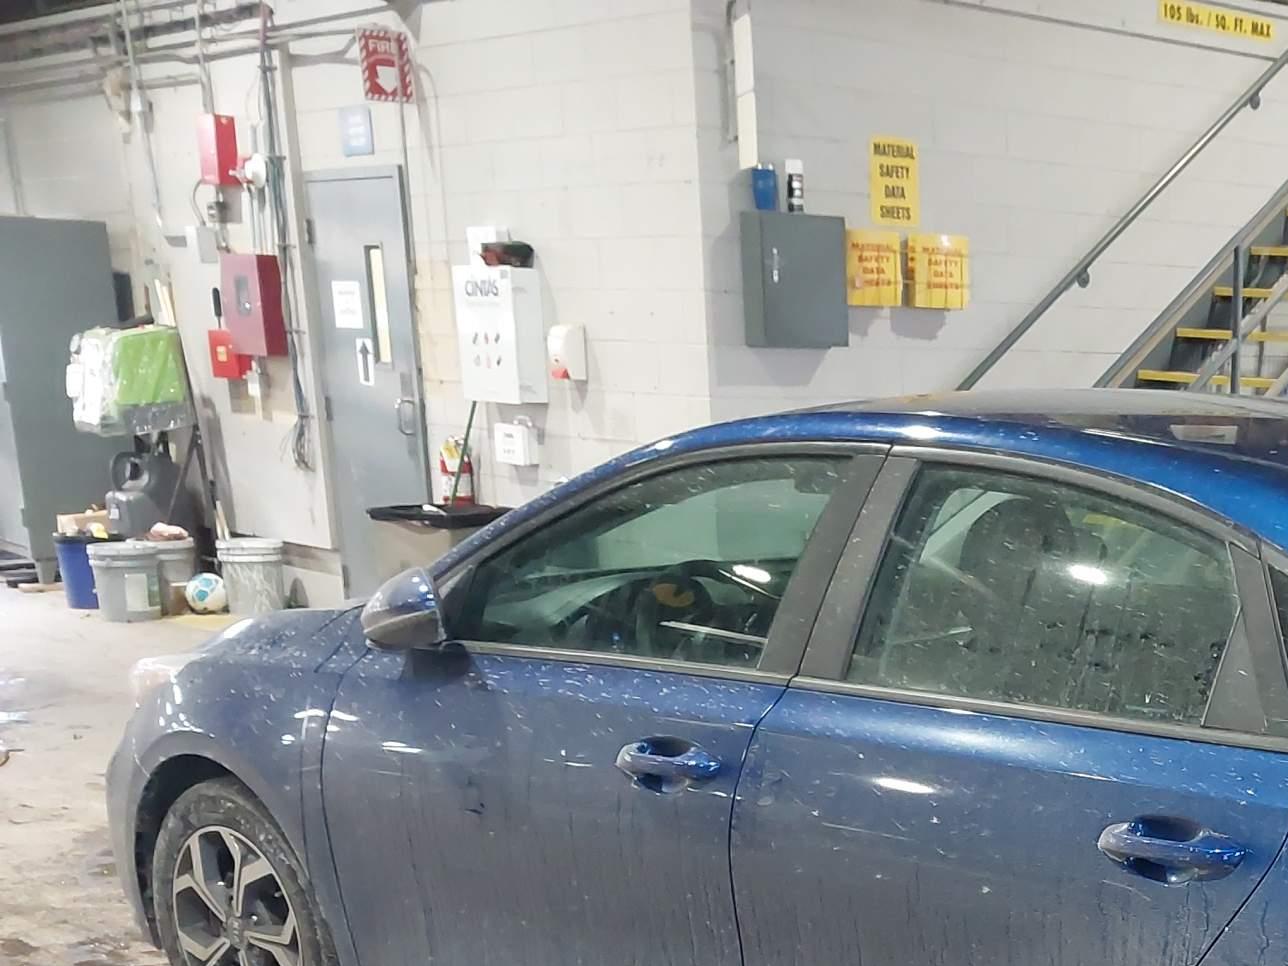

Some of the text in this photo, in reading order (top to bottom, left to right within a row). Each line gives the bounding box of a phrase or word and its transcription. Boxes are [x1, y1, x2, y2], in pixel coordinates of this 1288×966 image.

[1164, 3, 1271, 38] 105 lbs. / SQ. FT. MAX
[873, 142, 915, 160] MATERIAL
[879, 163, 909, 179] SAFETY
[884, 184, 905, 200] DATA
[879, 205, 911, 221] SHEETS
[862, 267, 885, 275] DATA
[465, 276, 499, 297] CINTAS
[858, 278, 892, 287] HEETS
